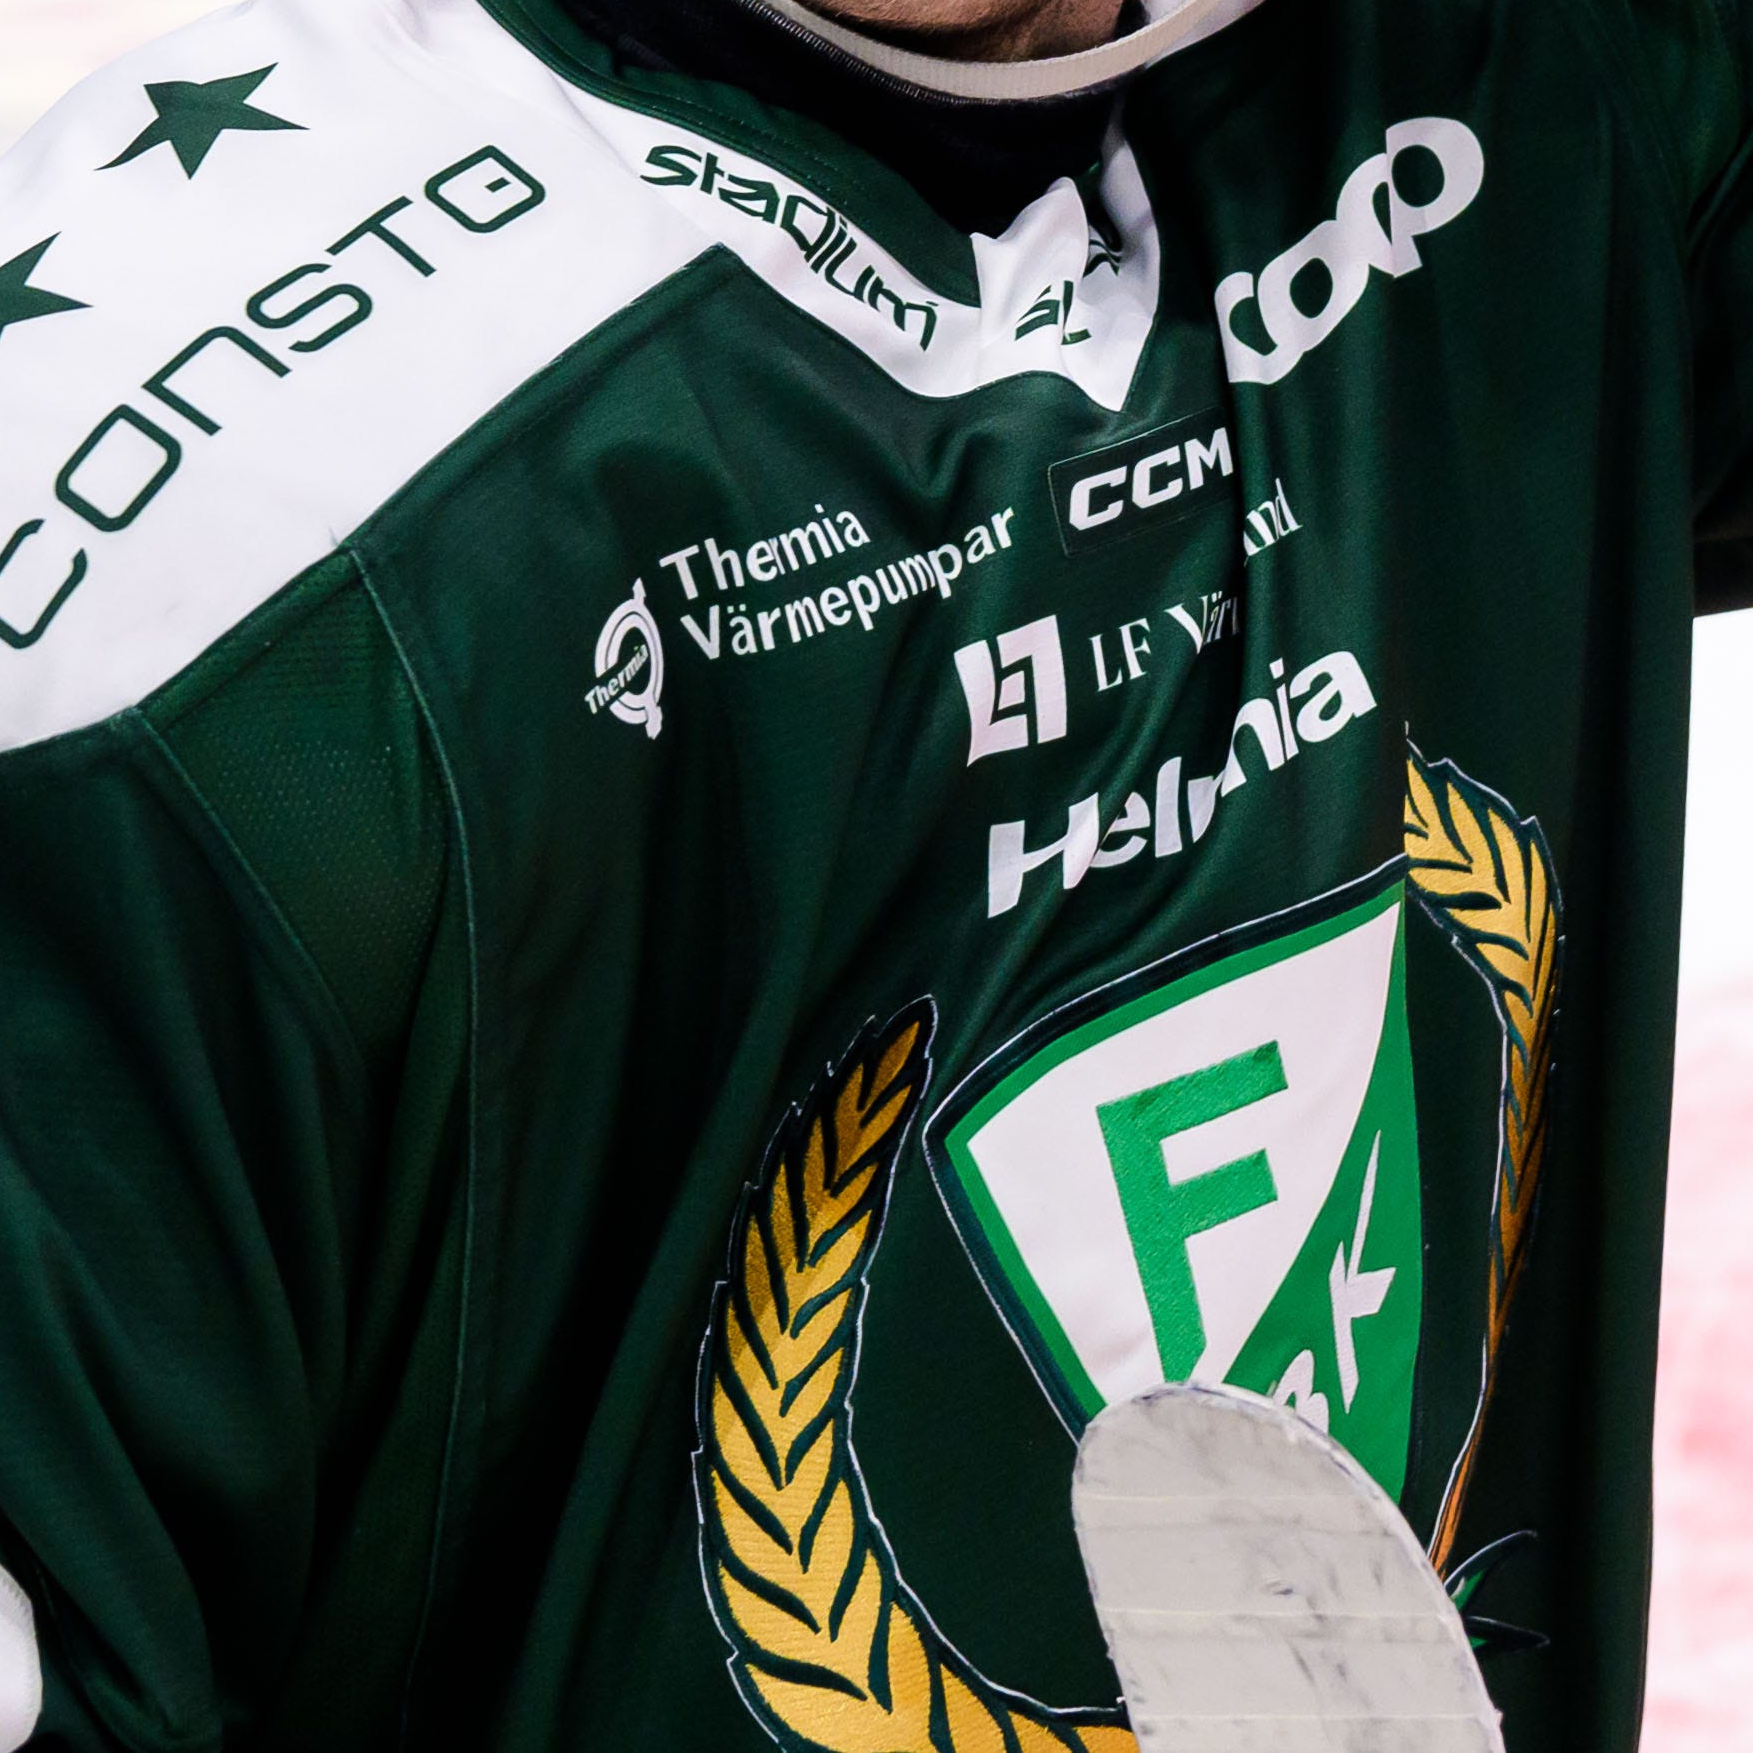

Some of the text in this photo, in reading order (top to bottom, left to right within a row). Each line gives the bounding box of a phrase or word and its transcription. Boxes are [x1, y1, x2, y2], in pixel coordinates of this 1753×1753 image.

[1213, 117, 1485, 386] coop
[1068, 425, 1235, 531] CCM
[659, 503, 871, 601] Thermia
[680, 506, 1017, 662] Värmepumpar
[1089, 617, 1152, 693] LF
